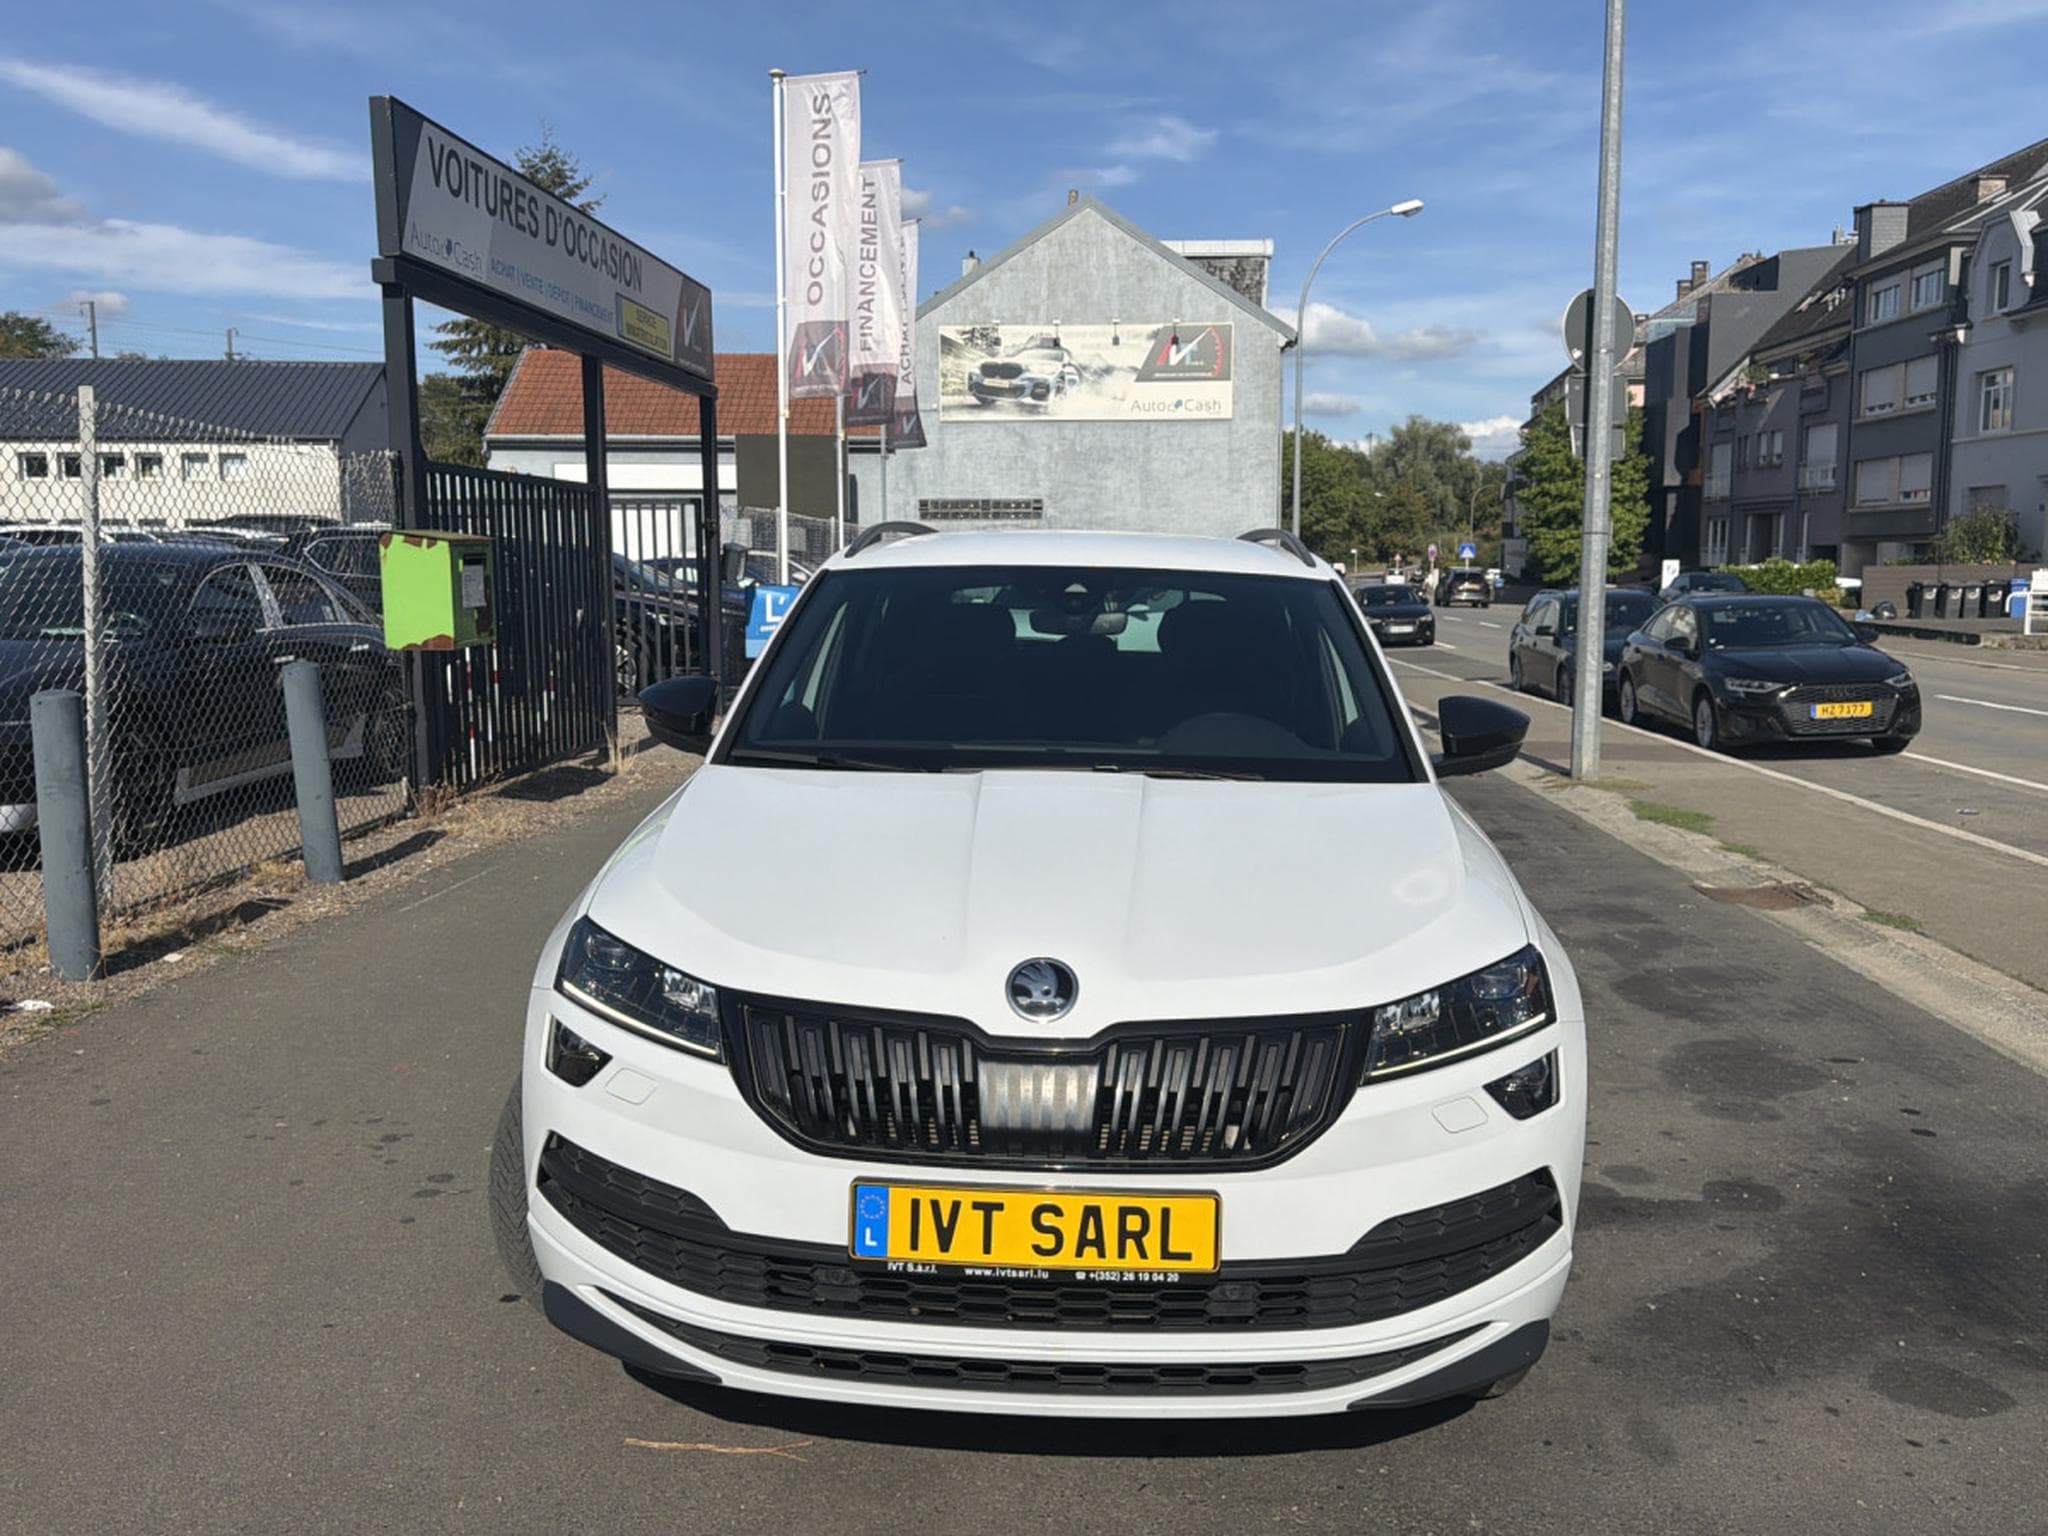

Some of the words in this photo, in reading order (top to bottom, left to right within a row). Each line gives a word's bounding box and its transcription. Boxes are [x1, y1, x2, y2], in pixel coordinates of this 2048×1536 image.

[428, 136, 539, 239] VOITURES
[545, 204, 643, 292] D'OCCASION
[807, 93, 832, 306] OCCASIONS
[860, 176, 878, 353] FINANCEMENT
[865, 1226, 878, 1247] L
[909, 1197, 1004, 1256] IVT
[1031, 1203, 1193, 1262] SARL
[886, 1262, 904, 1271] IVT
[964, 1266, 1050, 1280] www.ivtsarl.lu
